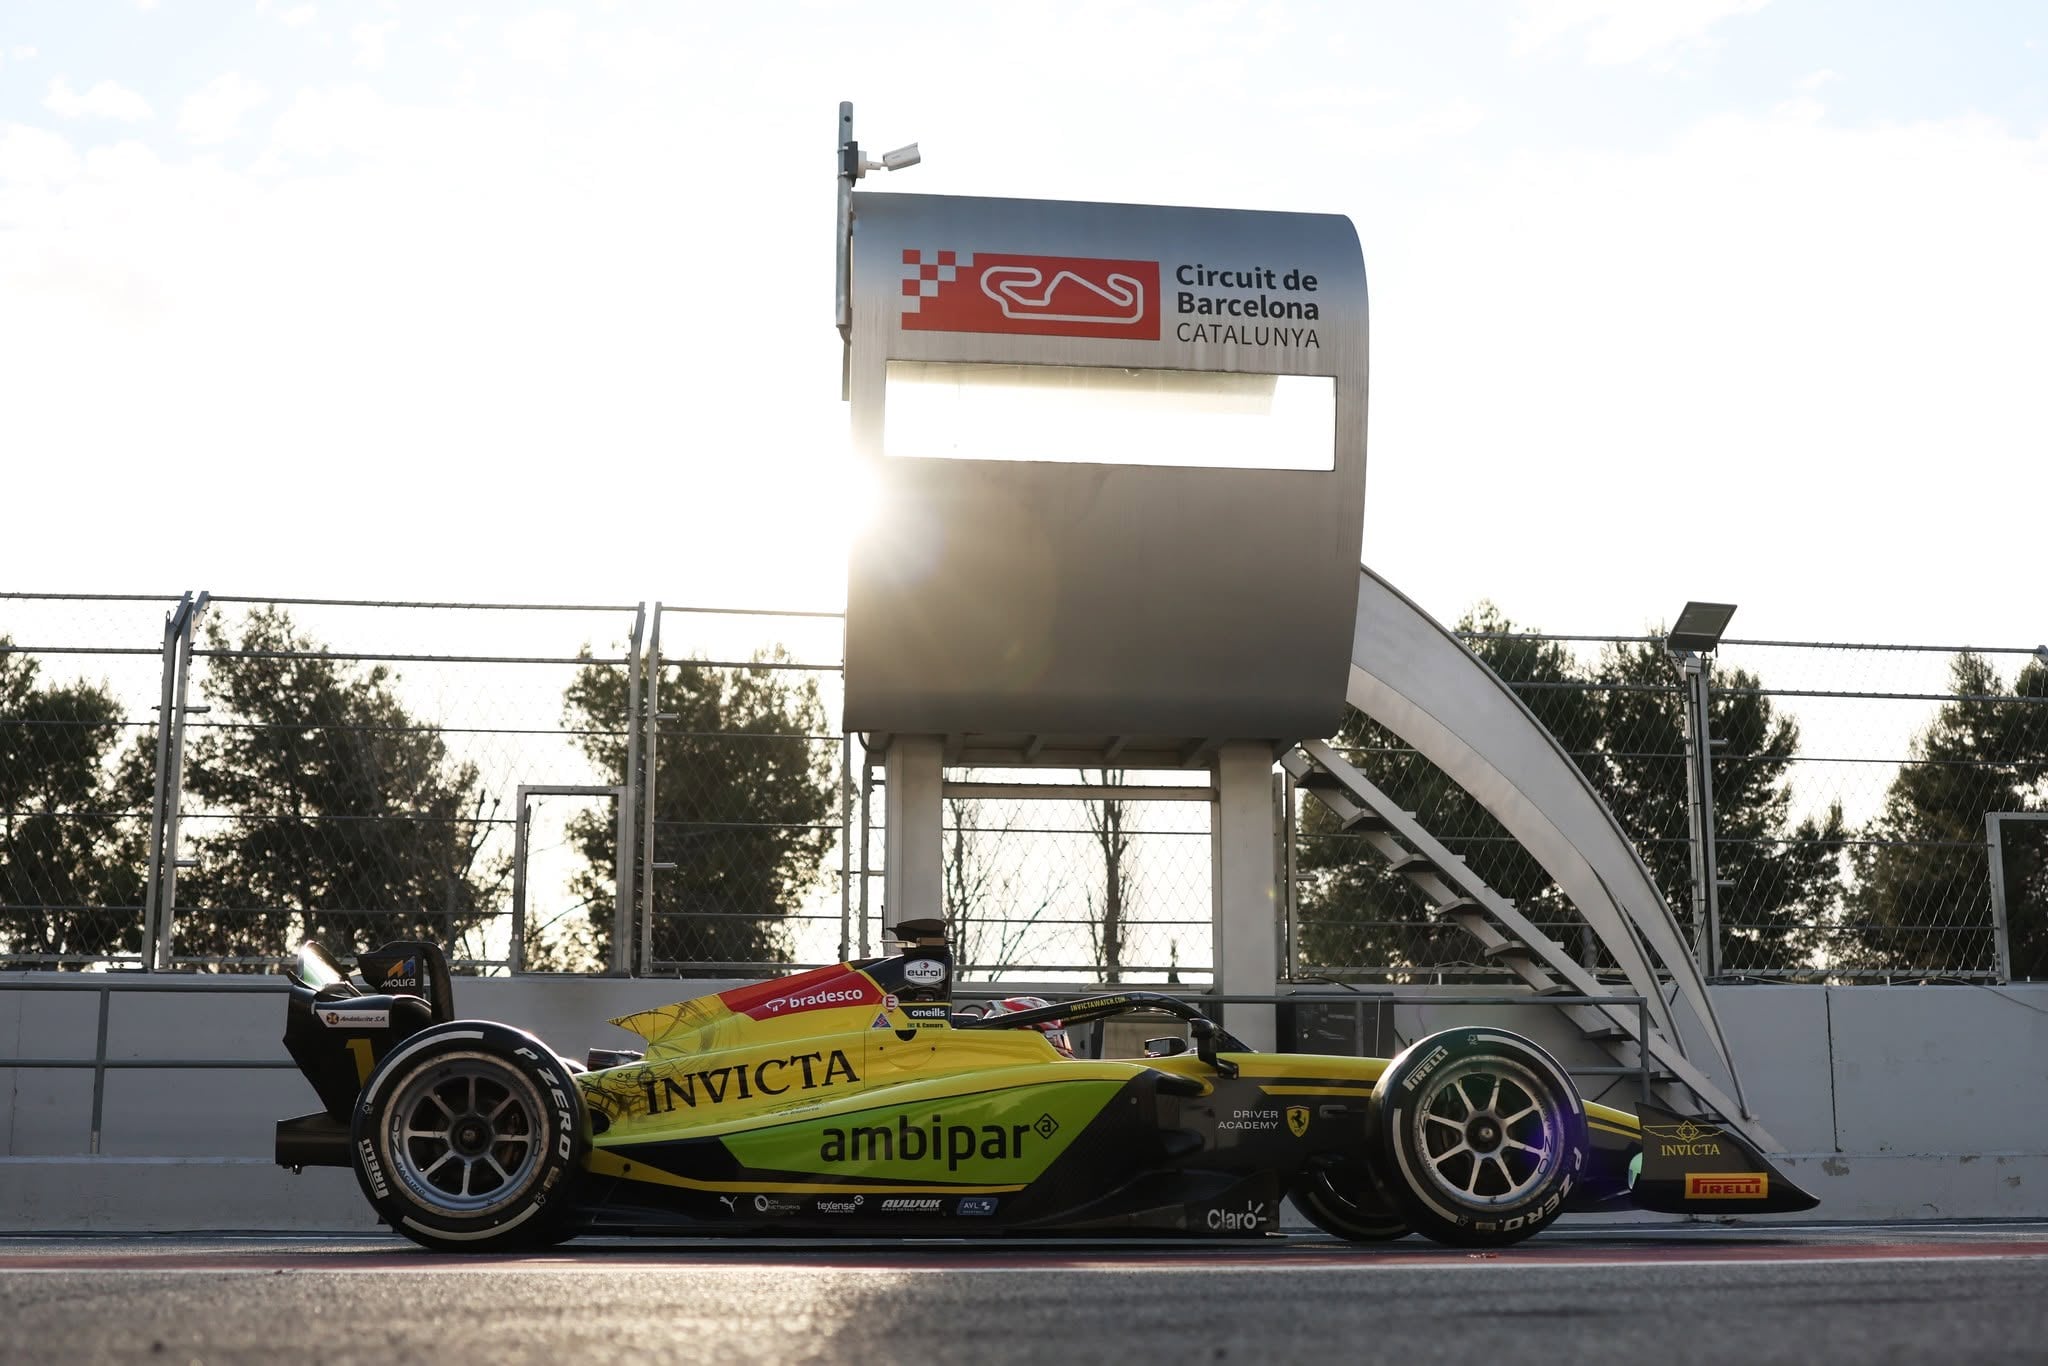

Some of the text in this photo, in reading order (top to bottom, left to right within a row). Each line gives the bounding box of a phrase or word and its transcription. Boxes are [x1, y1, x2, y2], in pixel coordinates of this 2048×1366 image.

[1176, 264, 1318, 292] Circuit de
[1177, 291, 1319, 321] Barcelona
[1177, 322, 1320, 349] CATALUNYA
[907, 968, 942, 977] eurol
[790, 989, 863, 1009] bradesco
[1402, 1045, 1449, 1091] PIRELLI
[646, 1050, 861, 1115] INVICTA
[514, 1047, 572, 1161] P ZERO
[1233, 1110, 1279, 1119] DRIVER
[1218, 1121, 1279, 1130] ACADEMY
[820, 1114, 1031, 1172] ambipar
[1661, 1144, 1721, 1157] INVICTA
[358, 1138, 390, 1200] PIRELLI
[1692, 1178, 1761, 1194] PIRELLI
[816, 1200, 856, 1212] texense
[1503, 1173, 1574, 1232] ZERO
[1207, 1208, 1257, 1230] Claro
